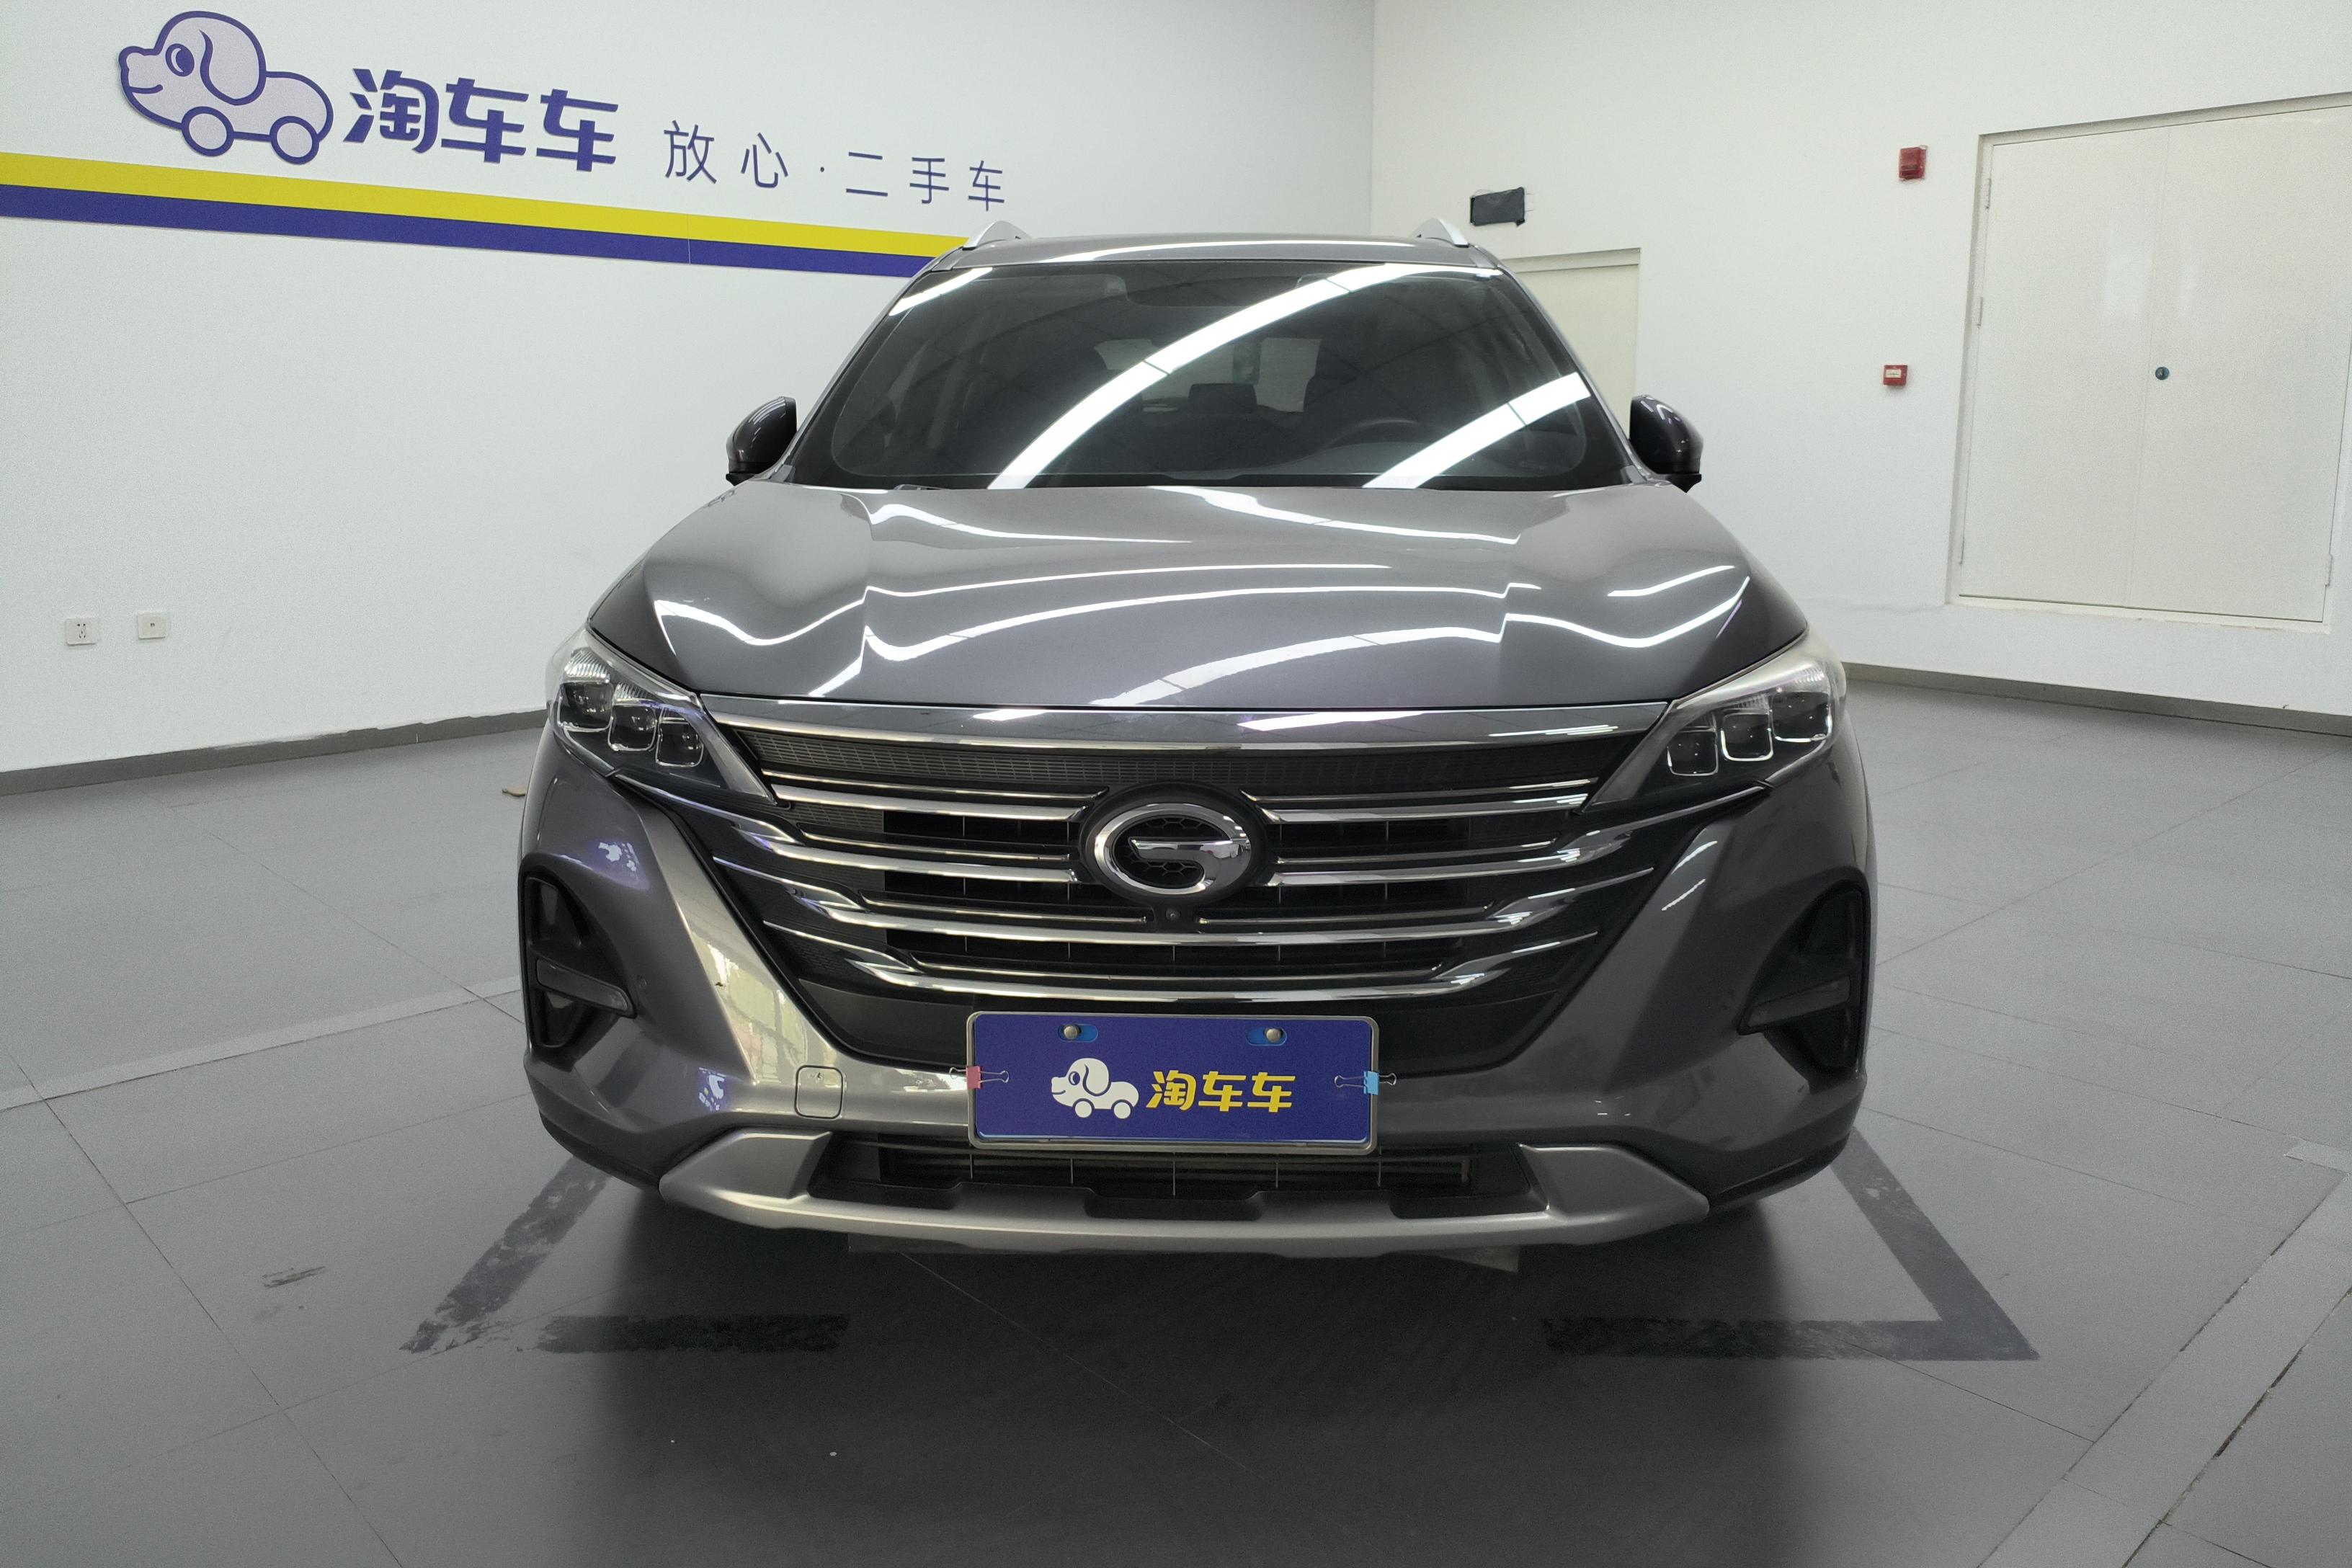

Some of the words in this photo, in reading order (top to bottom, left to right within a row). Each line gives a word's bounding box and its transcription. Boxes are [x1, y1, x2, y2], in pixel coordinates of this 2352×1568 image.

[343, 68, 619, 172] 淘车车
[1146, 1069, 1296, 1113] 淘车车
